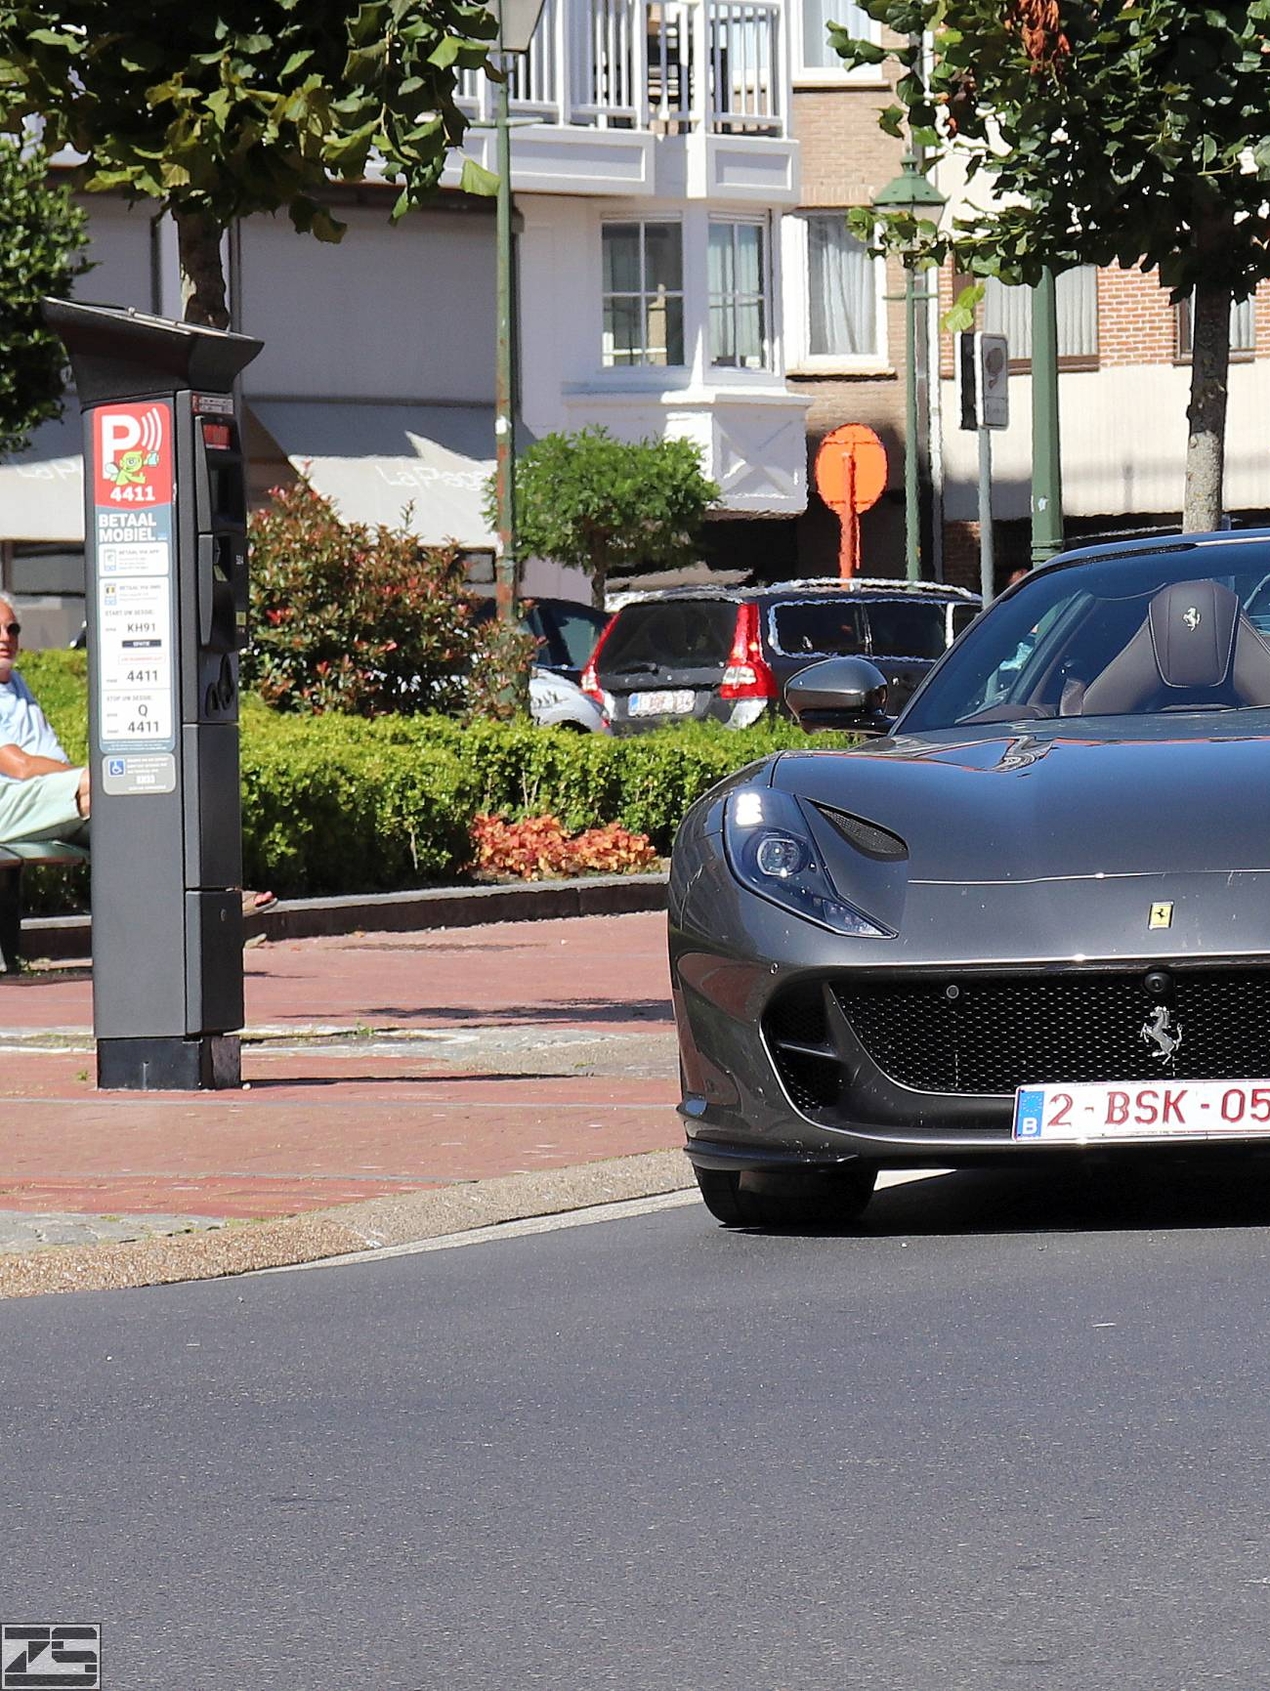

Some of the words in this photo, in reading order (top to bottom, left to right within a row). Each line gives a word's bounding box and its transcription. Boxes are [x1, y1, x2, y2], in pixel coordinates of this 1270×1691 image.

[110, 485, 156, 502] 4411
[98, 512, 157, 528] BETAAL
[99, 527, 156, 543] MOBIEL
[127, 623, 156, 633] KH91
[127, 669, 158, 682] 4411
[138, 704, 148, 718] Q
[127, 721, 159, 733] 4411
[1021, 1117, 1038, 1136] B
